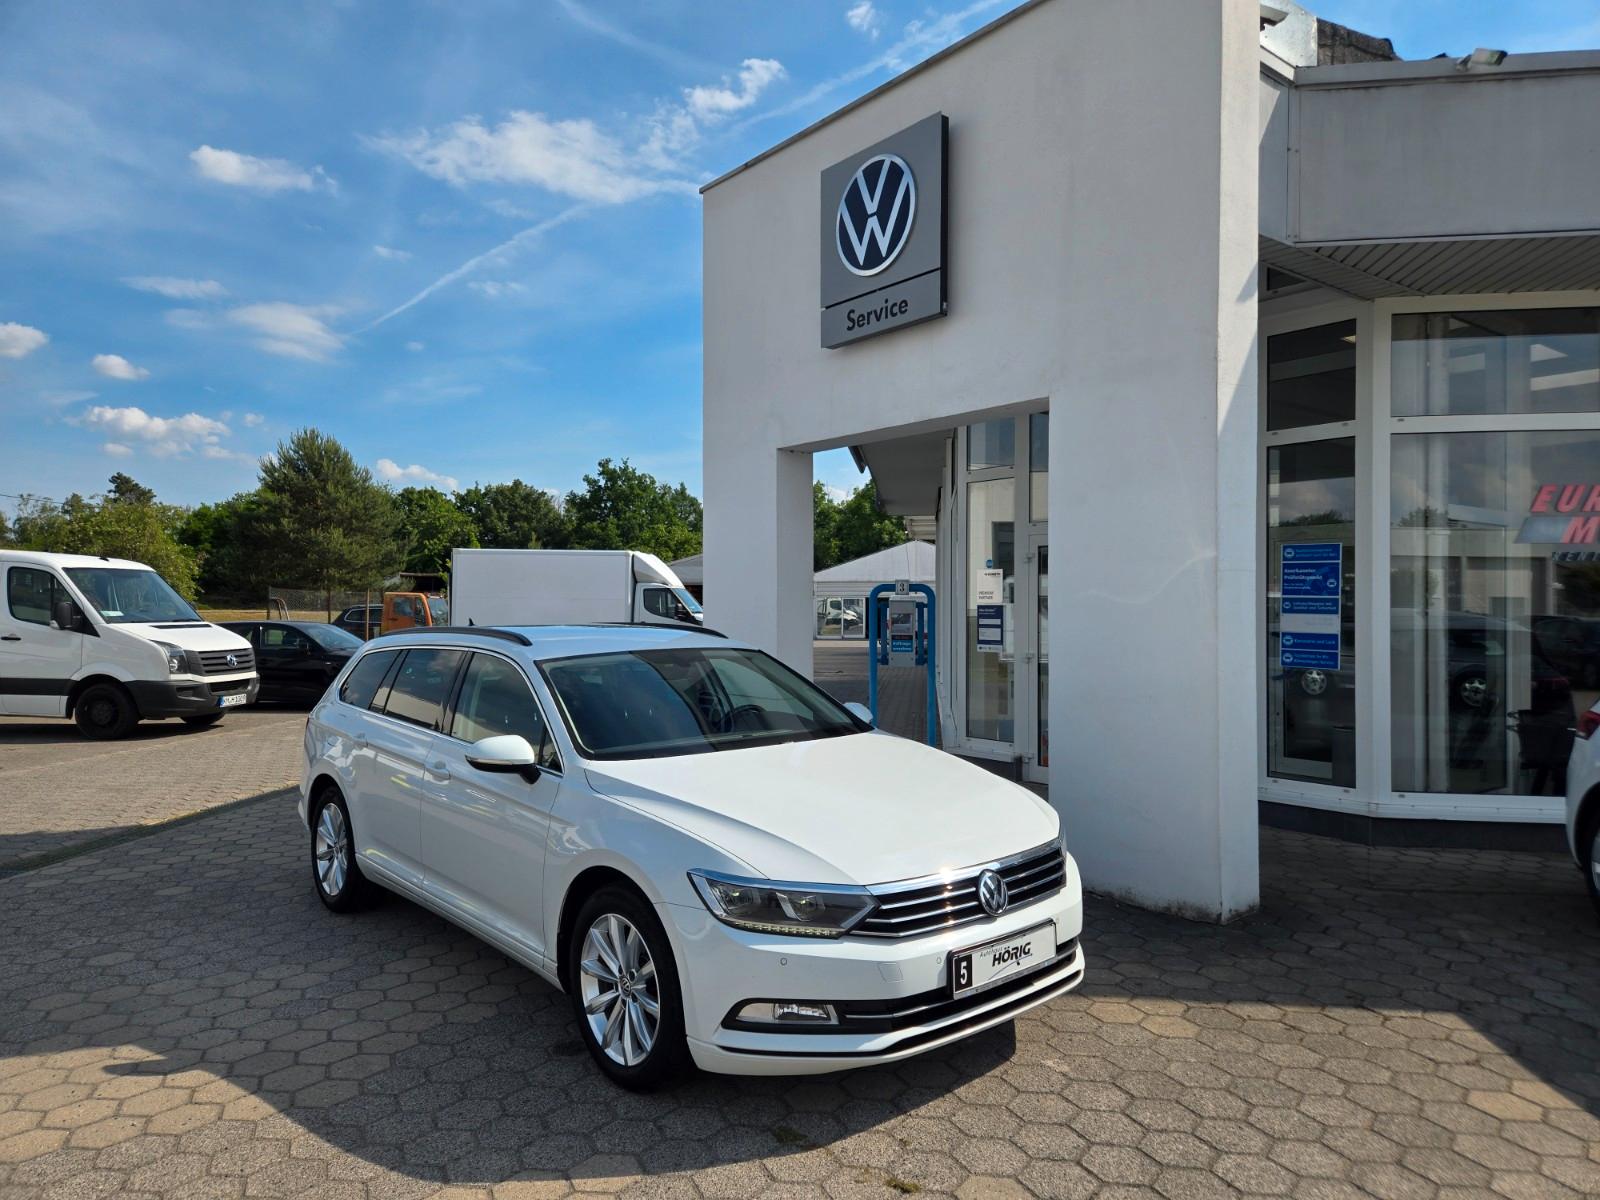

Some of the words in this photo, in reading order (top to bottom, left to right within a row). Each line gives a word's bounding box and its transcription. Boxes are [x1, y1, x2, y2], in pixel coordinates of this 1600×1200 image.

[838, 155, 914, 272] VW
[846, 298, 908, 332] Service
[899, 582, 905, 593] 3
[992, 941, 1031, 967] HÖRIG
[960, 961, 968, 985] 5
